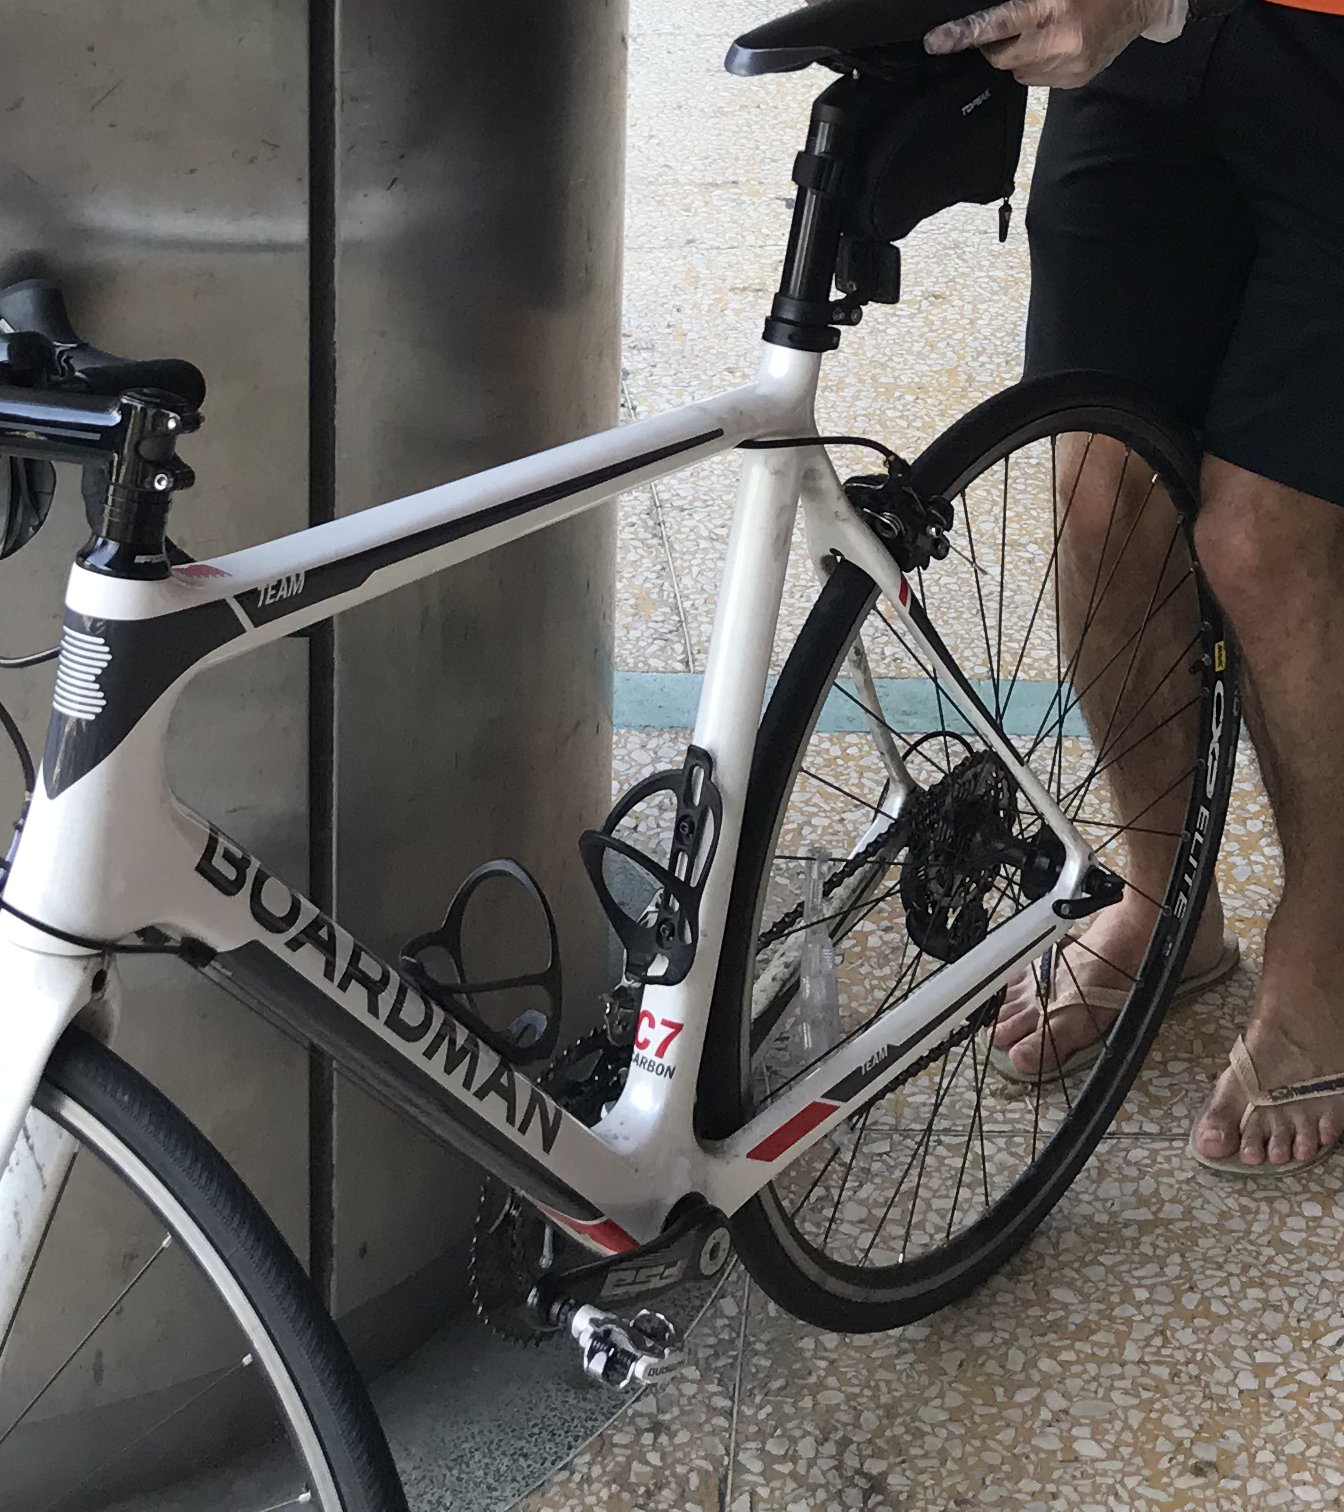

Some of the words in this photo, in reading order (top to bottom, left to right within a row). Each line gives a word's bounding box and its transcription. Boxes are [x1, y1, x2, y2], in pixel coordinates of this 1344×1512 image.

[255, 571, 307, 609] TEAM
[1173, 804, 1210, 919] ELITE
[194, 824, 564, 1156] BOARDMAN
[634, 1008, 685, 1060] C7
[632, 1051, 677, 1079] ARBON
[859, 1044, 888, 1076] TEAM
